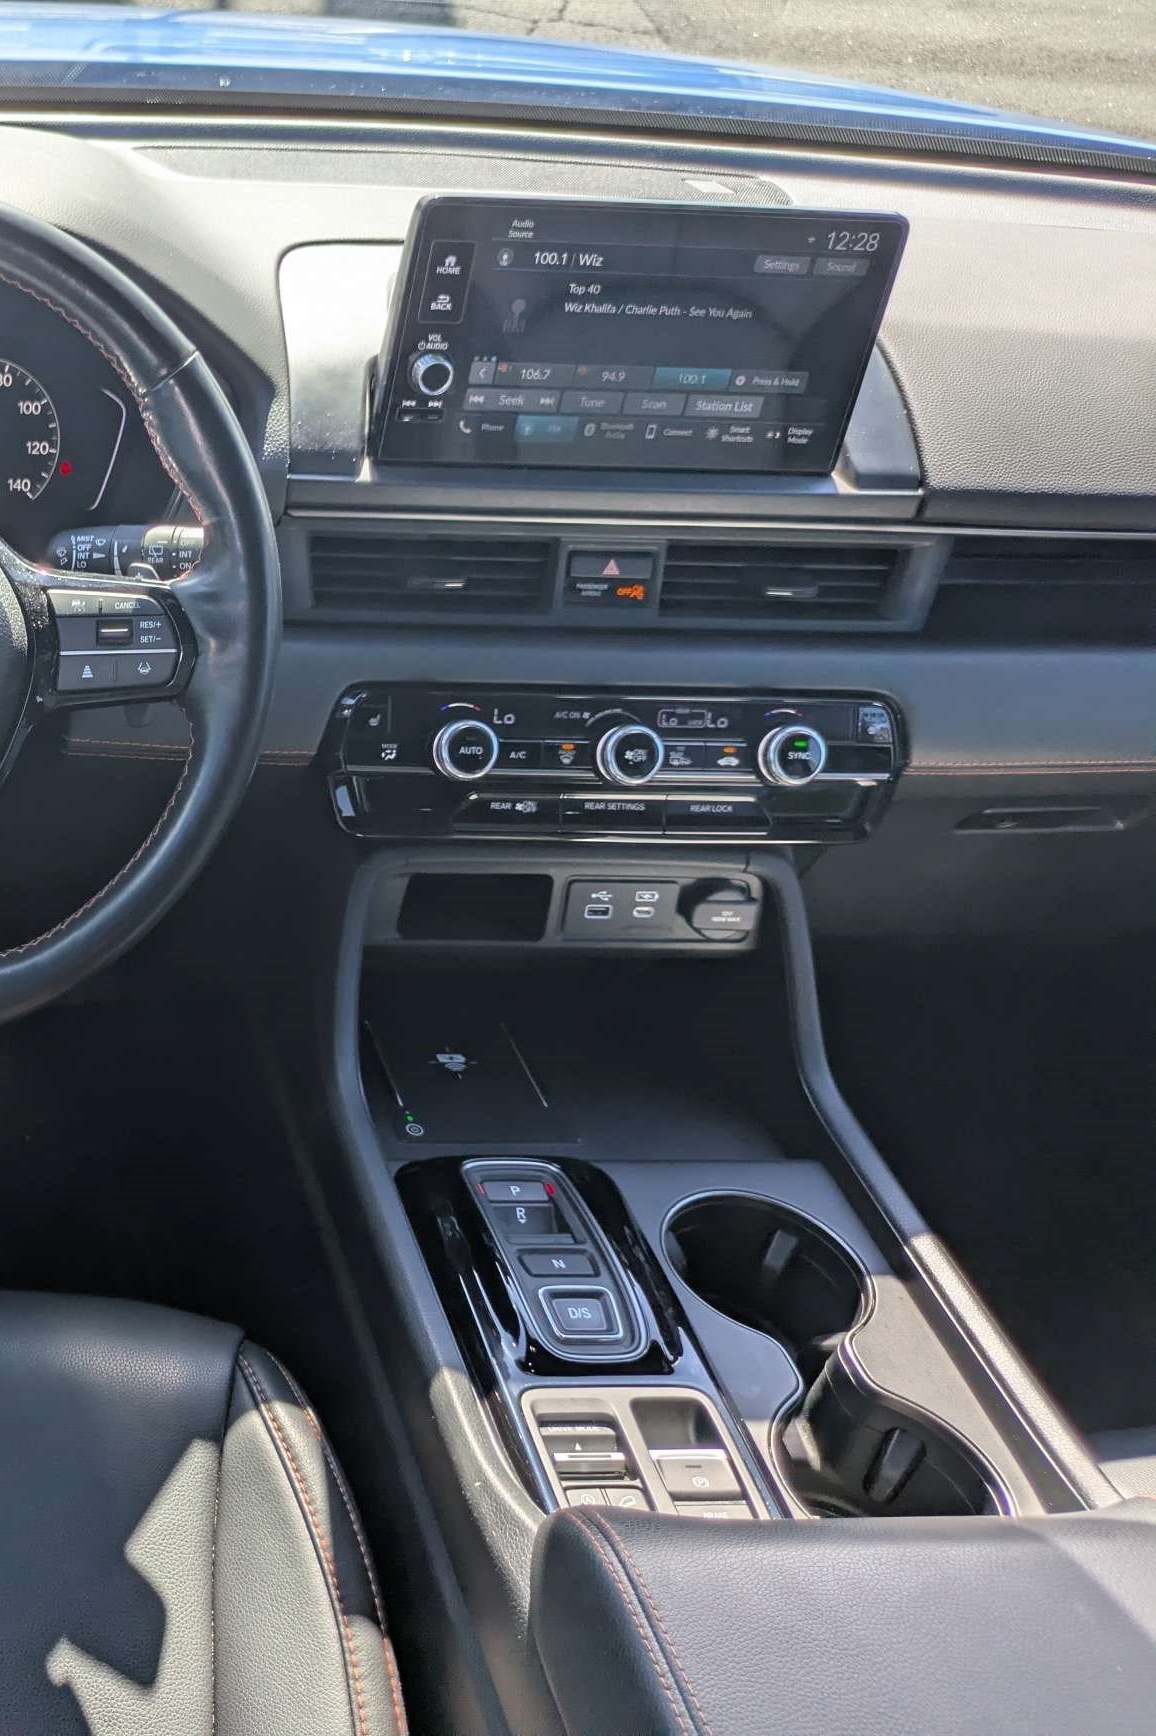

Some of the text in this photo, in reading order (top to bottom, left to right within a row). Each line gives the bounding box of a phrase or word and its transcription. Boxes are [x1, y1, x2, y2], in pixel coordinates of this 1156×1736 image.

[511, 219, 535, 229] Audio
[508, 230, 534, 239] Source
[826, 231, 880, 252] 12:28
[534, 251, 604, 267] 100.1 Wiz
[436, 266, 461, 275] HOME
[763, 259, 800, 272] Settings
[568, 283, 601, 296] Top 40
[430, 302, 452, 311] BACK
[564, 302, 582, 313] Wiz
[584, 302, 616, 314] Khalifa
[625, 303, 656, 315] Charlie
[659, 305, 681, 316] Puth
[688, 306, 706, 317] See
[708, 307, 726, 318] You
[727, 308, 752, 320] Again
[427, 334, 442, 342] VOL
[426, 342, 448, 351] AUDIO
[520, 368, 551, 380] 106.7
[601, 370, 626, 383] 94.9
[678, 373, 707, 385] 100.1
[498, 395, 525, 407] Seek
[579, 396, 605, 408] Tune
[641, 399, 667, 410] Scan
[695, 400, 753, 412] Station List
[17, 401, 41, 415] 100
[26, 441, 50, 455] 120
[7, 478, 31, 492] 140
[77, 543, 92, 551] OFF
[77, 552, 90, 560] INT
[179, 551, 192, 559] INT
[76, 561, 87, 569] LO
[139, 621, 162, 630] RES/+
[459, 745, 484, 756] AUTO
[509, 750, 527, 760] A/C
[787, 751, 811, 760] SYNC
[490, 802, 512, 810] REAR
[584, 802, 645, 811] REAR SETTINGS
[690, 804, 733, 813] REAR LOCK
[509, 1185, 521, 1197] P
[515, 1207, 526, 1219] R
[551, 1259, 567, 1269] N
[567, 1307, 592, 1320] D/S
